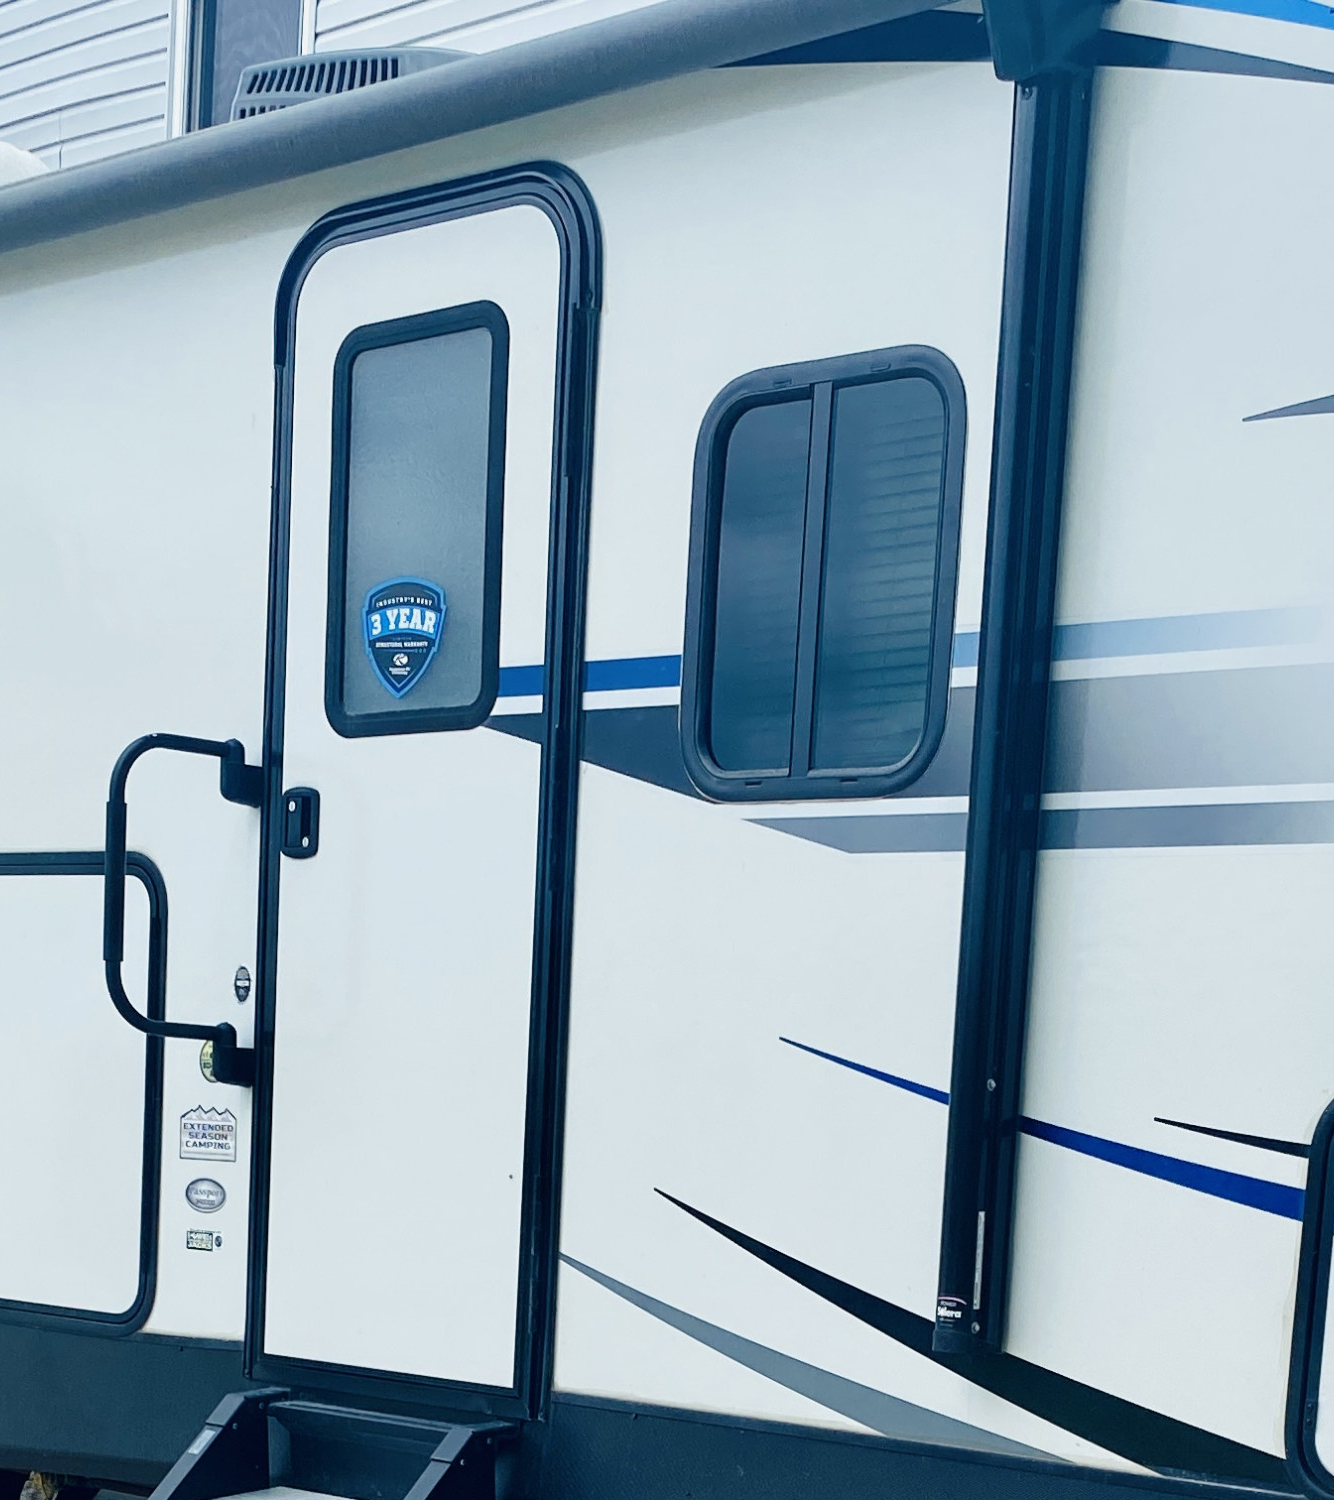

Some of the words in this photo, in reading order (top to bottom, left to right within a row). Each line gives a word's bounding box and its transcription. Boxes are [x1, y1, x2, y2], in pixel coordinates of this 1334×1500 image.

[370, 613, 382, 636] 3
[386, 608, 436, 634] YEAR
[183, 1123, 234, 1132] EXTENDED
[188, 1131, 228, 1141] SEASON
[185, 1140, 231, 1150] CAMPING
